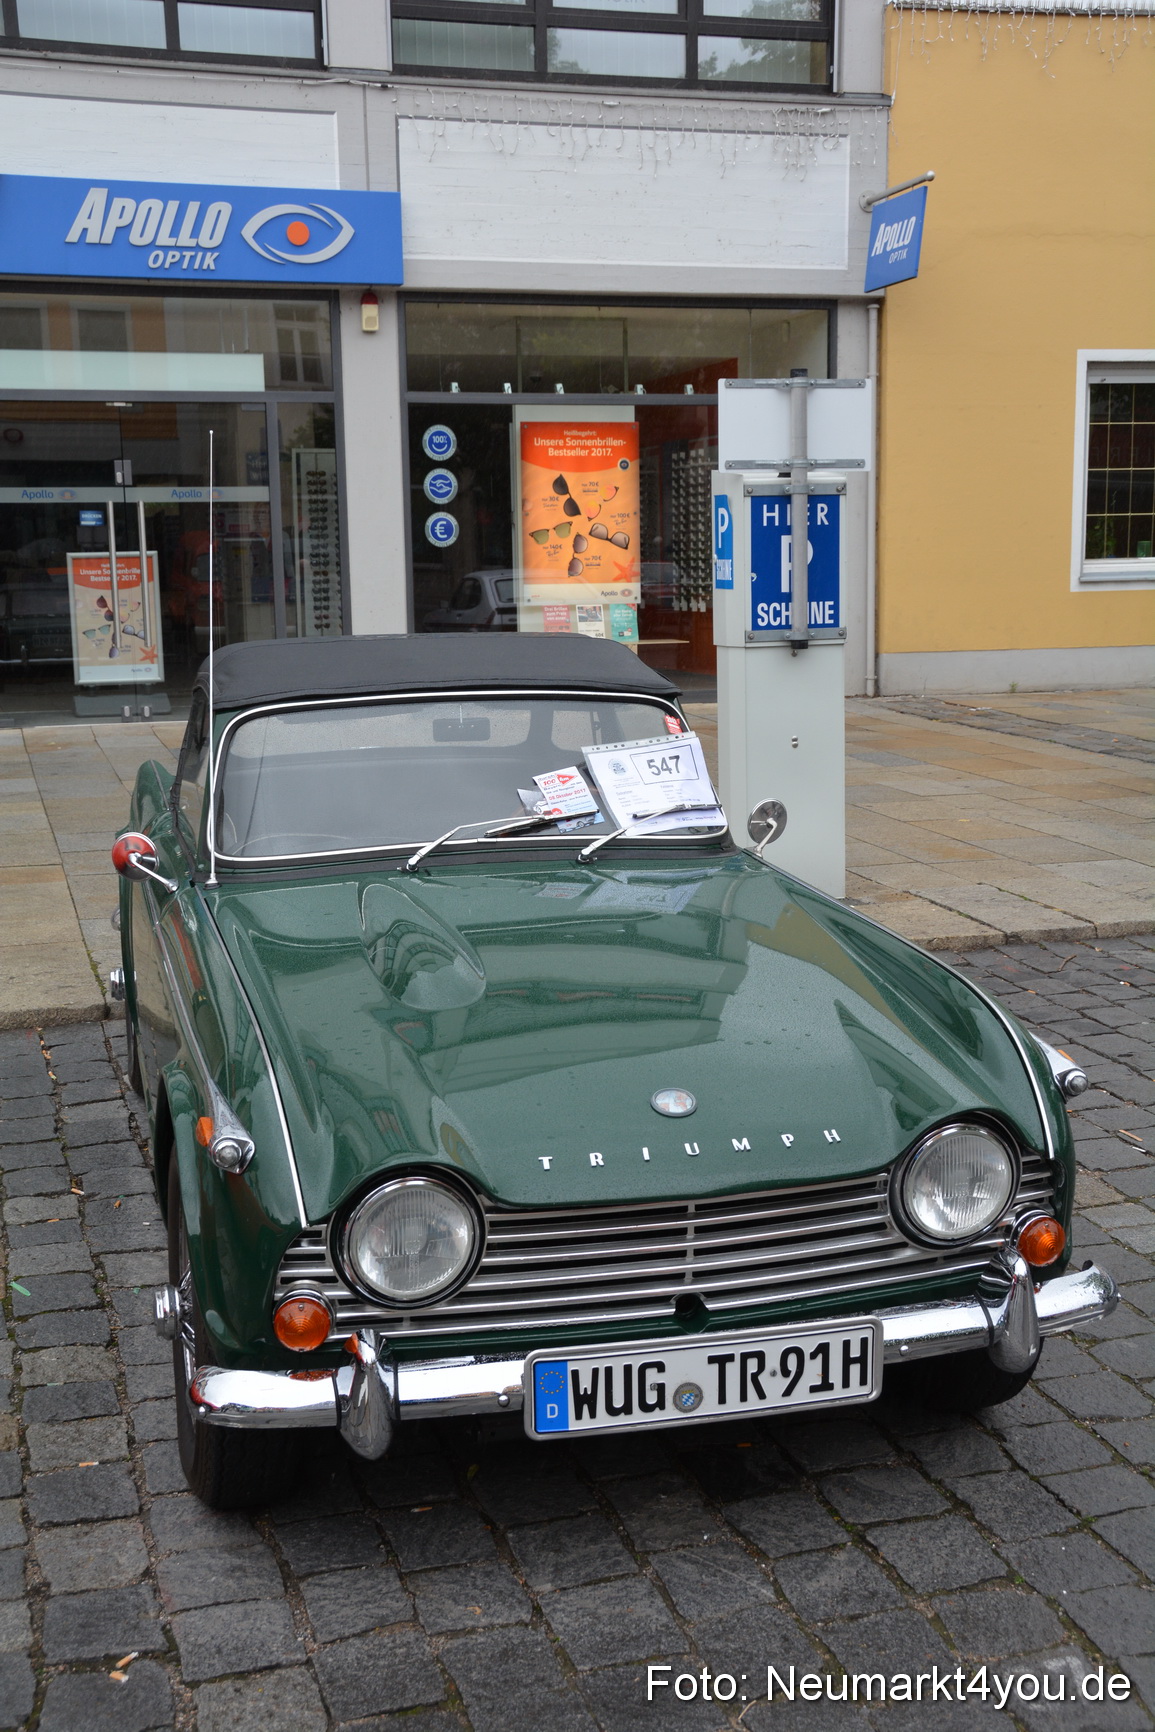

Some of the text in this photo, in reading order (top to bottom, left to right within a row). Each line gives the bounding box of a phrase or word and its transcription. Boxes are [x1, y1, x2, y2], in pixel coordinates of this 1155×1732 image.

[65, 187, 232, 249] APOLLO
[871, 216, 917, 257] APOLLO
[148, 250, 220, 270] OPTIK
[888, 248, 909, 264] OPTIK
[534, 437, 626, 446] Unsere Sonnenbrillen-
[548, 448, 613, 456] Bestseller 2017.
[21, 489, 54, 500] Apollo
[171, 488, 202, 500] Apollo
[762, 503, 829, 527] HIR
[718, 507, 729, 549] P
[757, 600, 835, 627] SCHINE
[646, 755, 680, 776] 547
[538, 1129, 841, 1171] TRIUMPH
[571, 1360, 666, 1420] WUG
[546, 1403, 559, 1419] D
